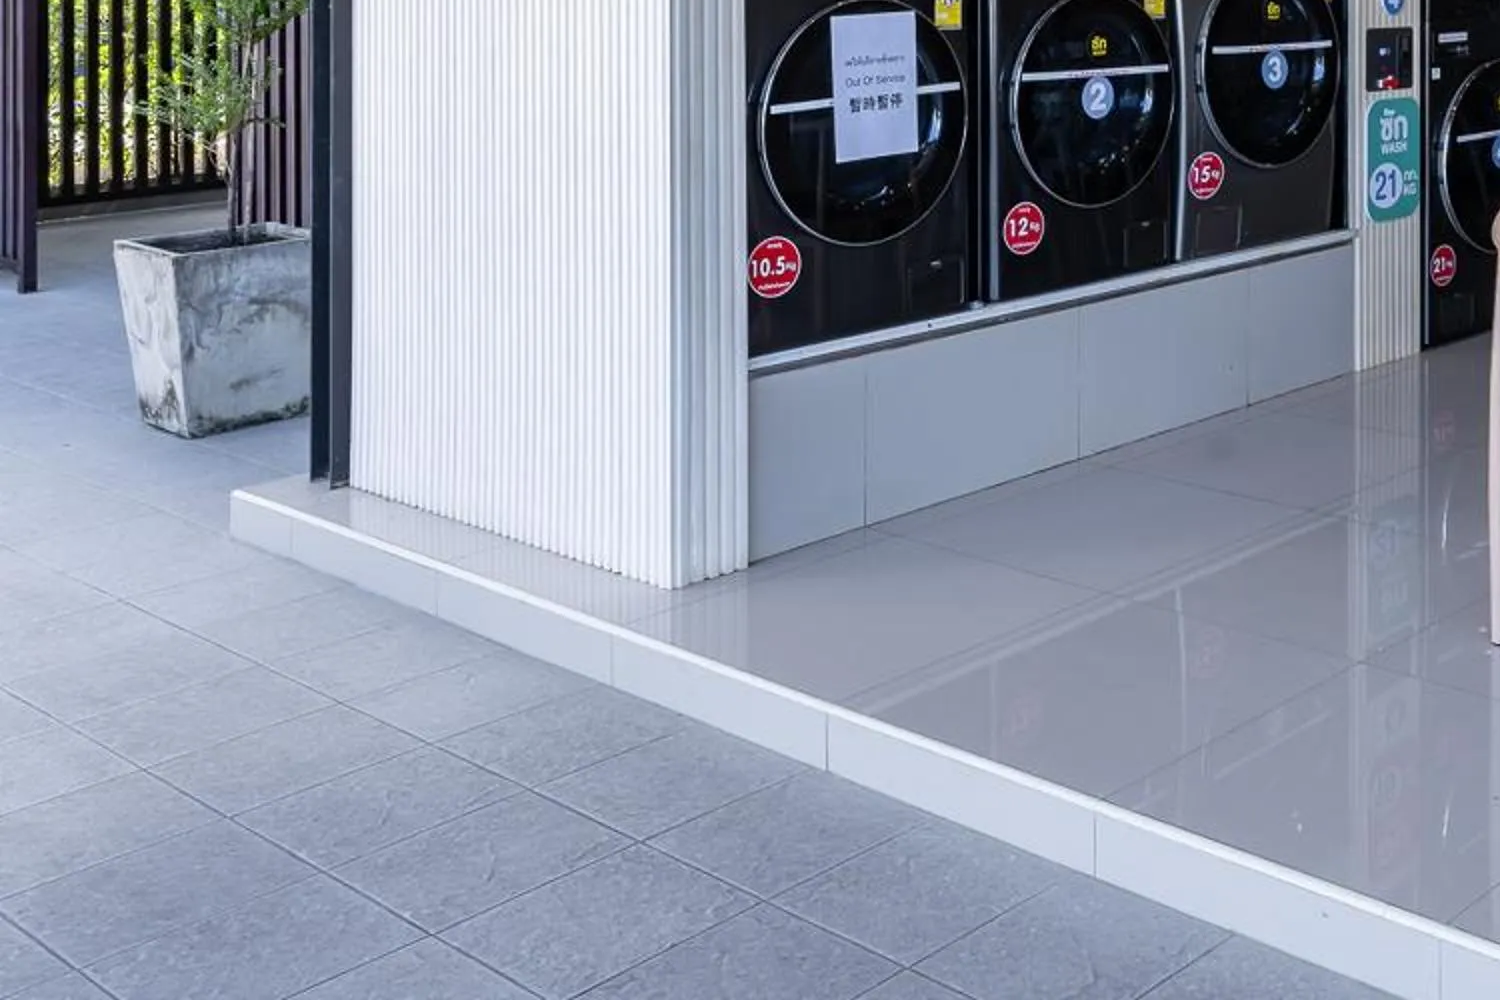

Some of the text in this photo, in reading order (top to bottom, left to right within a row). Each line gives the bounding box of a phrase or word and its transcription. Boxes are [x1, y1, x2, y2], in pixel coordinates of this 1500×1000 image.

[1268, 57, 1281, 82] 3
[1091, 82, 1106, 110] 2
[1380, 108, 1408, 141] ซัก
[1381, 142, 1407, 155] WASH
[1194, 165, 1210, 184] 15
[1375, 169, 1398, 200] 21
[1010, 217, 1029, 237] 12
[752, 255, 785, 278] 10.5
[1434, 257, 1446, 272] 21
